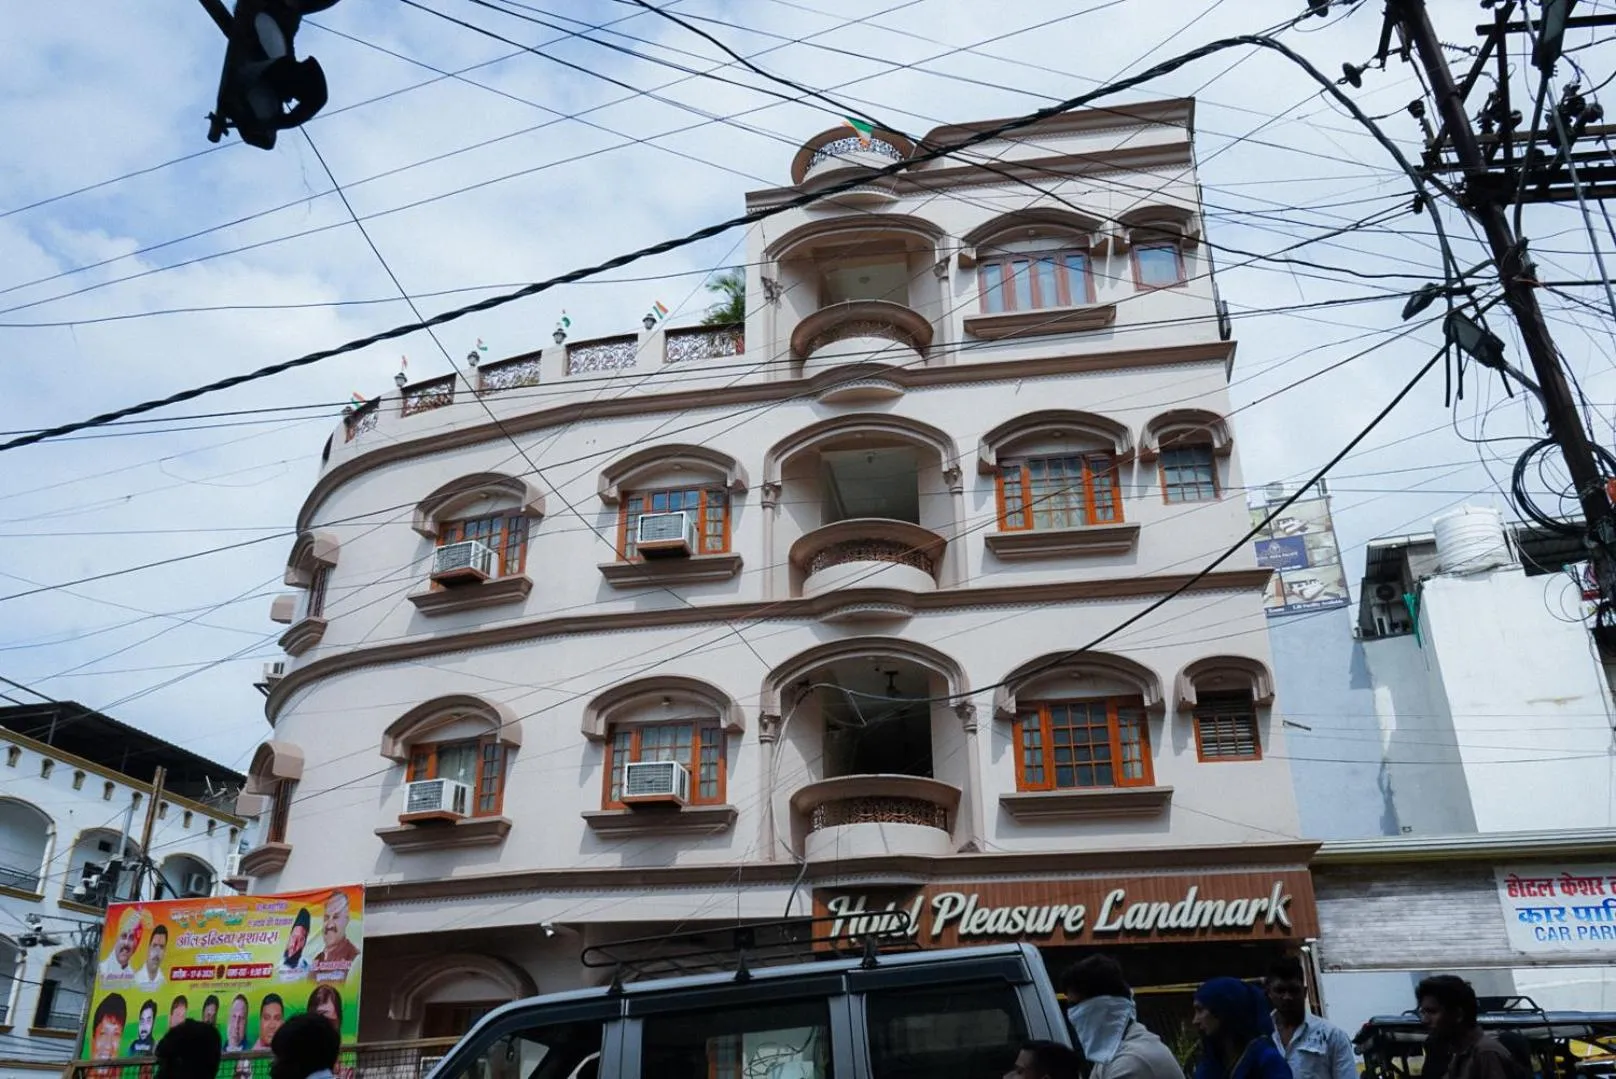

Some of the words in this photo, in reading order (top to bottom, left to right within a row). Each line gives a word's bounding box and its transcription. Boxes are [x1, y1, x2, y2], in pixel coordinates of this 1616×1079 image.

[1504, 873, 1556, 897] होटल
[1557, 872, 1606, 896] केशर
[930, 891, 1086, 936] Pleasure
[1092, 880, 1293, 931] Landmark
[1515, 906, 1566, 922] कार
[1535, 926, 1571, 941] CAR
